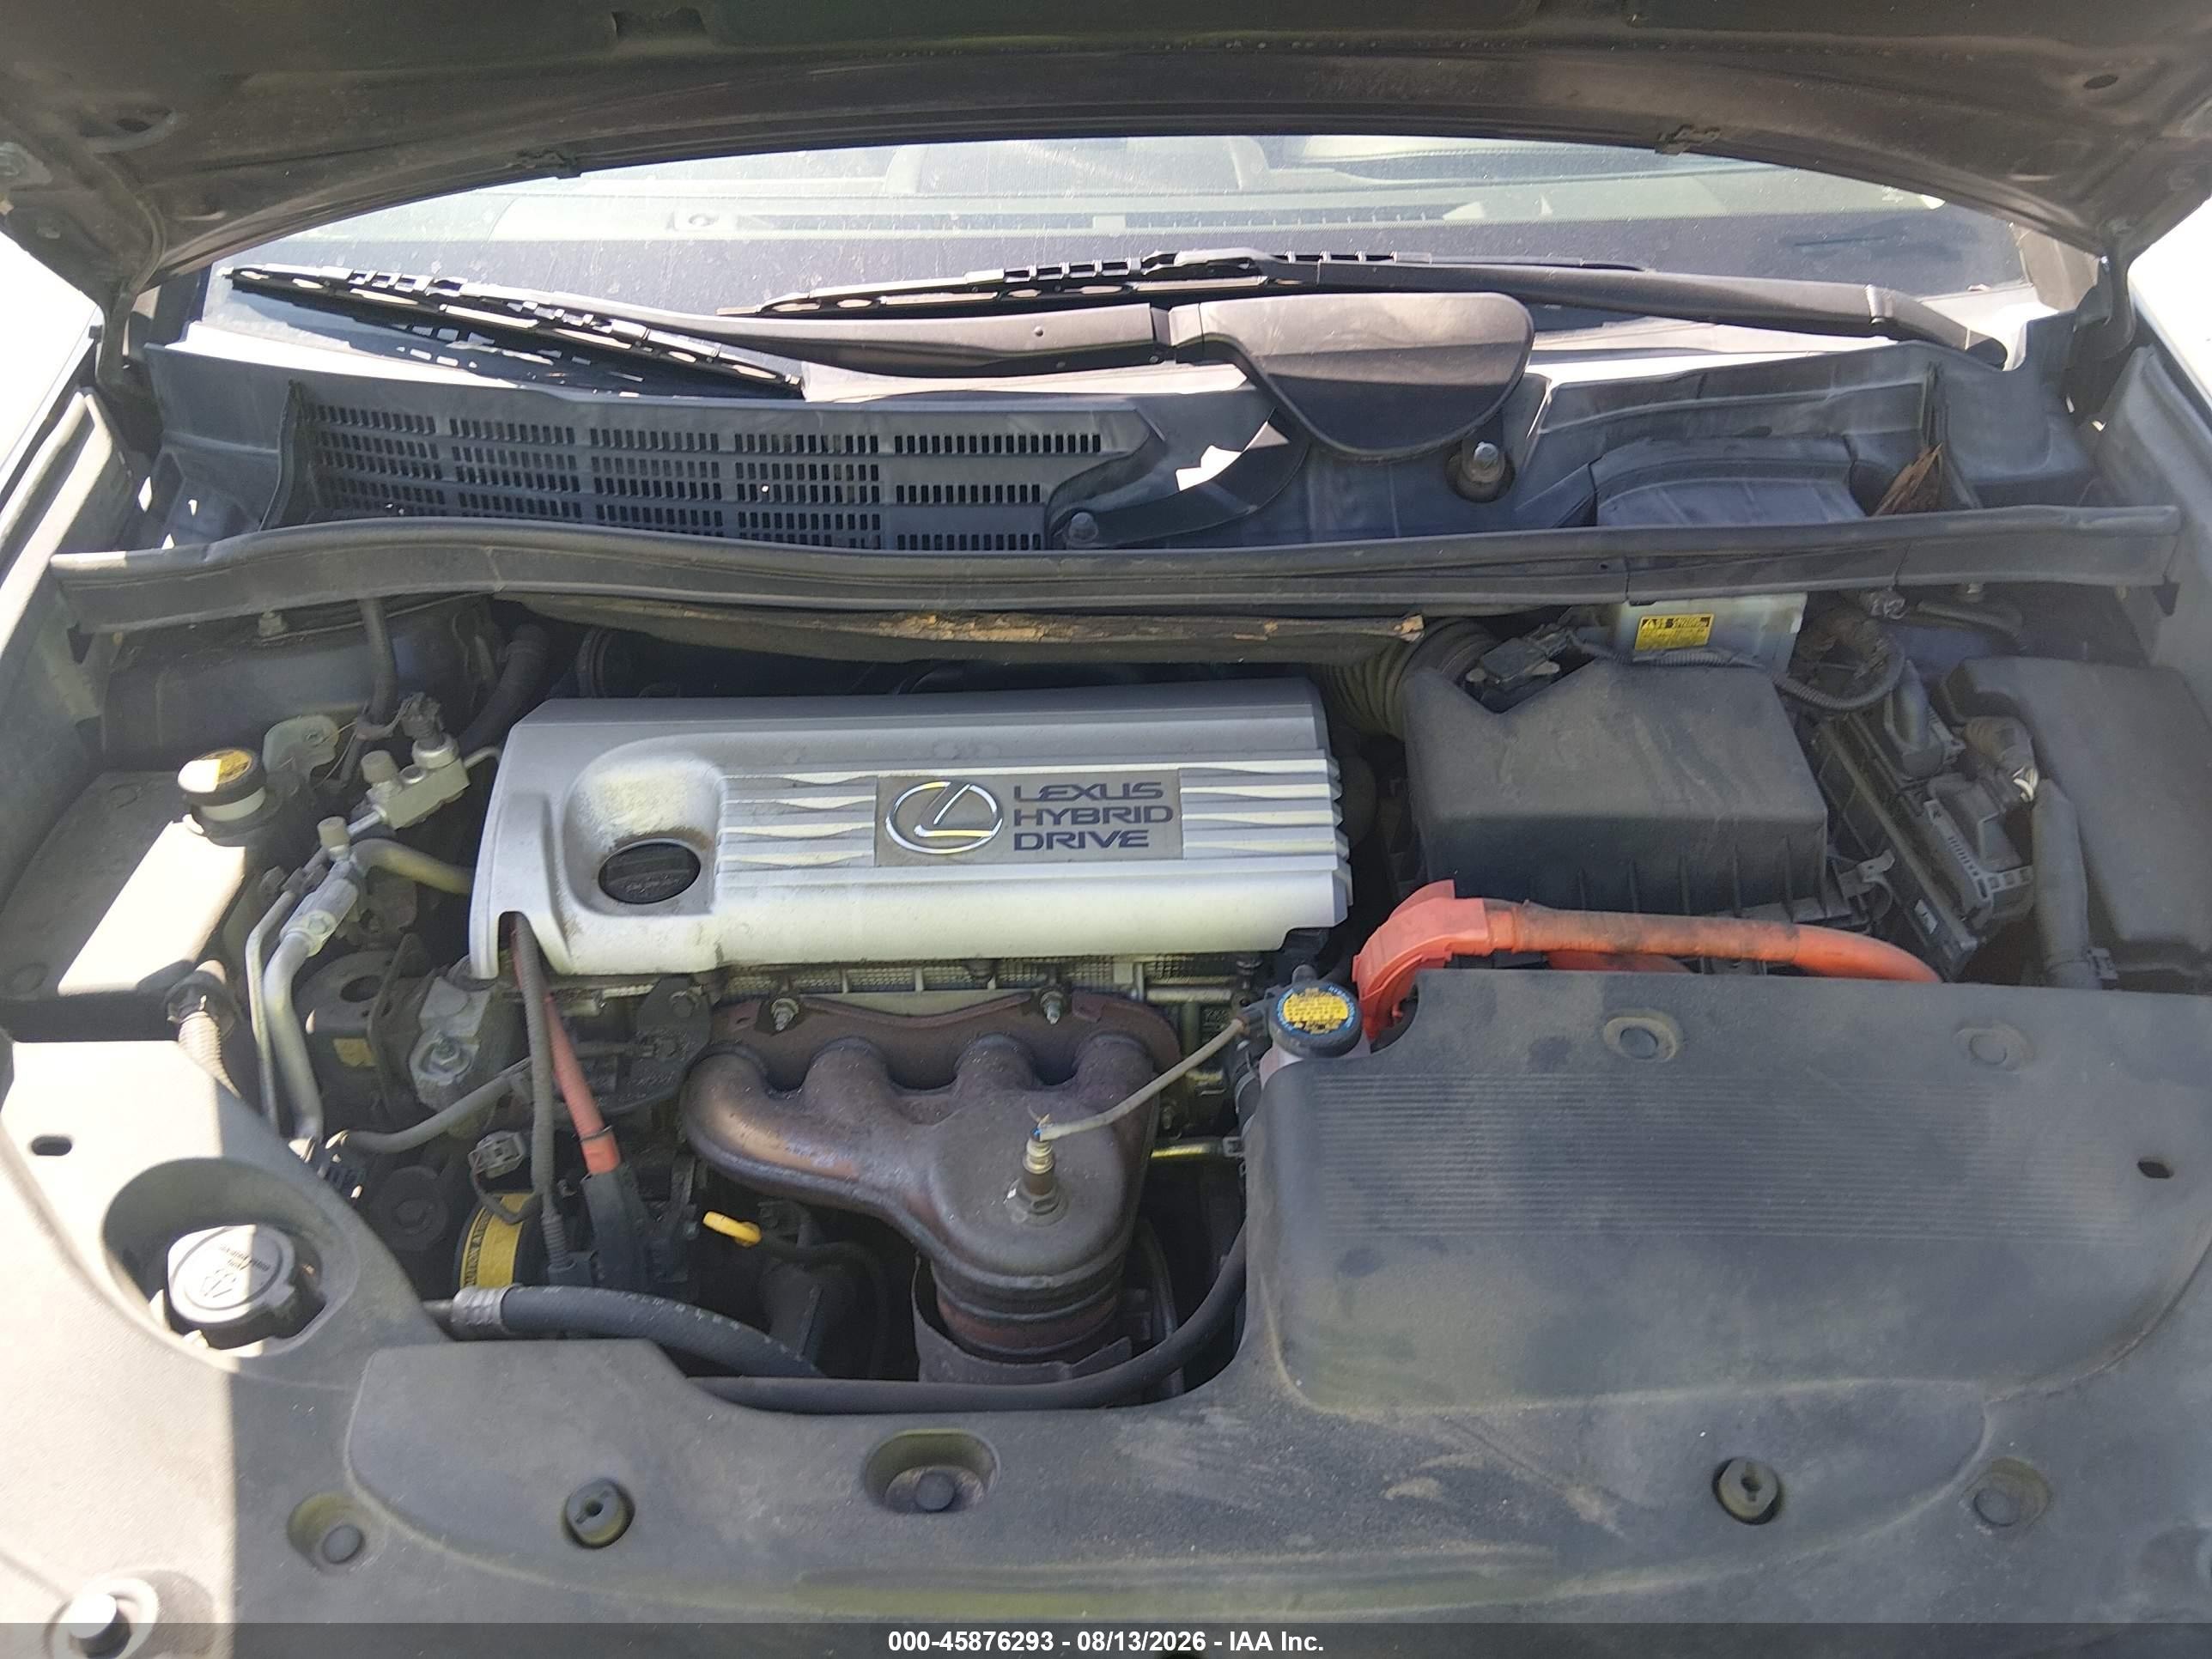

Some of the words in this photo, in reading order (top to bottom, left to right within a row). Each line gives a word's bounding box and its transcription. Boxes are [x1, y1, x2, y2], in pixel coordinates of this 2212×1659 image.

[1013, 781, 1164, 802] LEXUS
[1013, 805, 1174, 827] HYBRID
[1013, 830, 1149, 851] DRIVE
